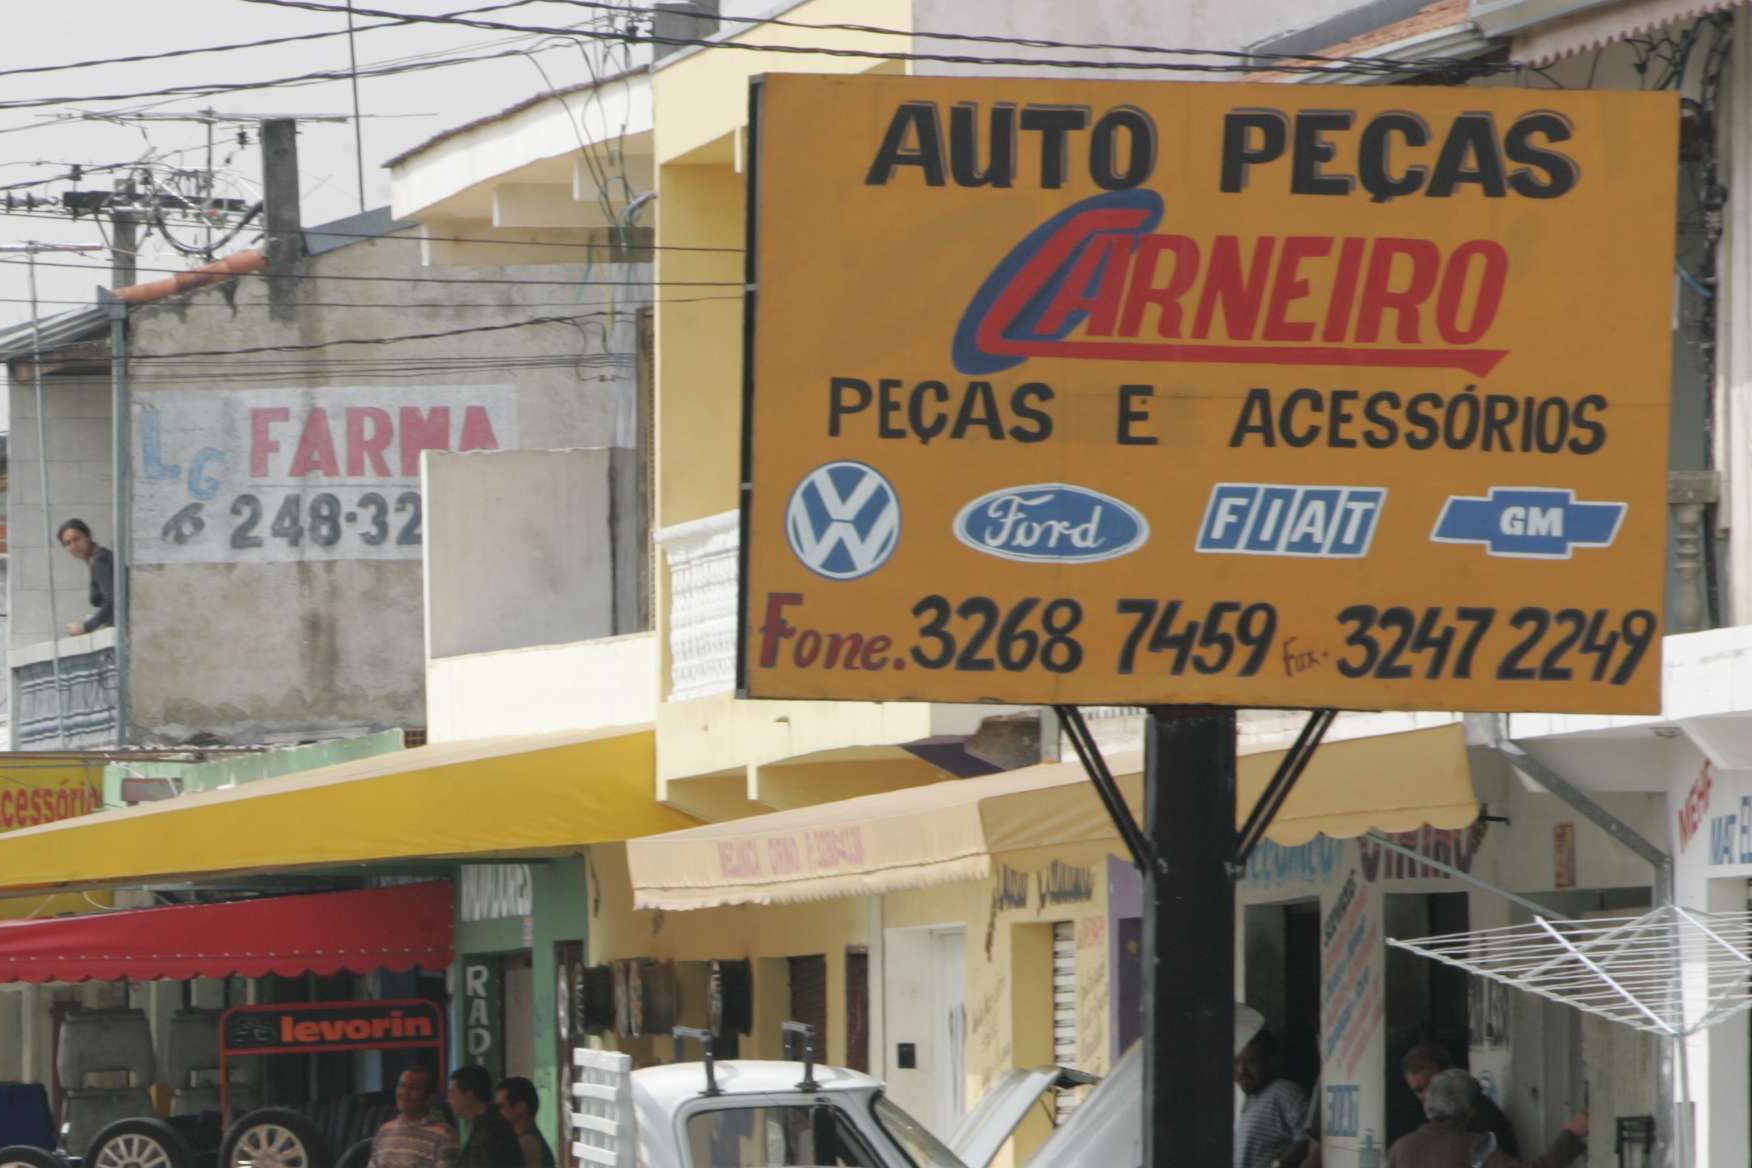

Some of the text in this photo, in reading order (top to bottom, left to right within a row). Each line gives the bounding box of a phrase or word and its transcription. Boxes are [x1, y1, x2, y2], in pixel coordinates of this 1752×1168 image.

[863, 101, 1583, 204] AUTO PEÇAS
[952, 190, 1511, 377] CARNEIRO
[250, 405, 500, 478] FARMA
[828, 378, 1608, 456] PEÇAS E ACESSÓRIOS
[229, 491, 423, 550] 248-32
[983, 493, 1106, 549] Ford
[1209, 497, 1377, 546] FIAT
[1498, 505, 1564, 538] GM
[759, 592, 907, 671] Fone.
[910, 594, 1085, 674] 3268
[1116, 598, 1277, 678] 7459
[1335, 605, 1498, 680] 3247
[1496, 608, 1658, 686] 2249
[279, 1009, 433, 1044] levorin
[464, 964, 493, 1067] RAD
